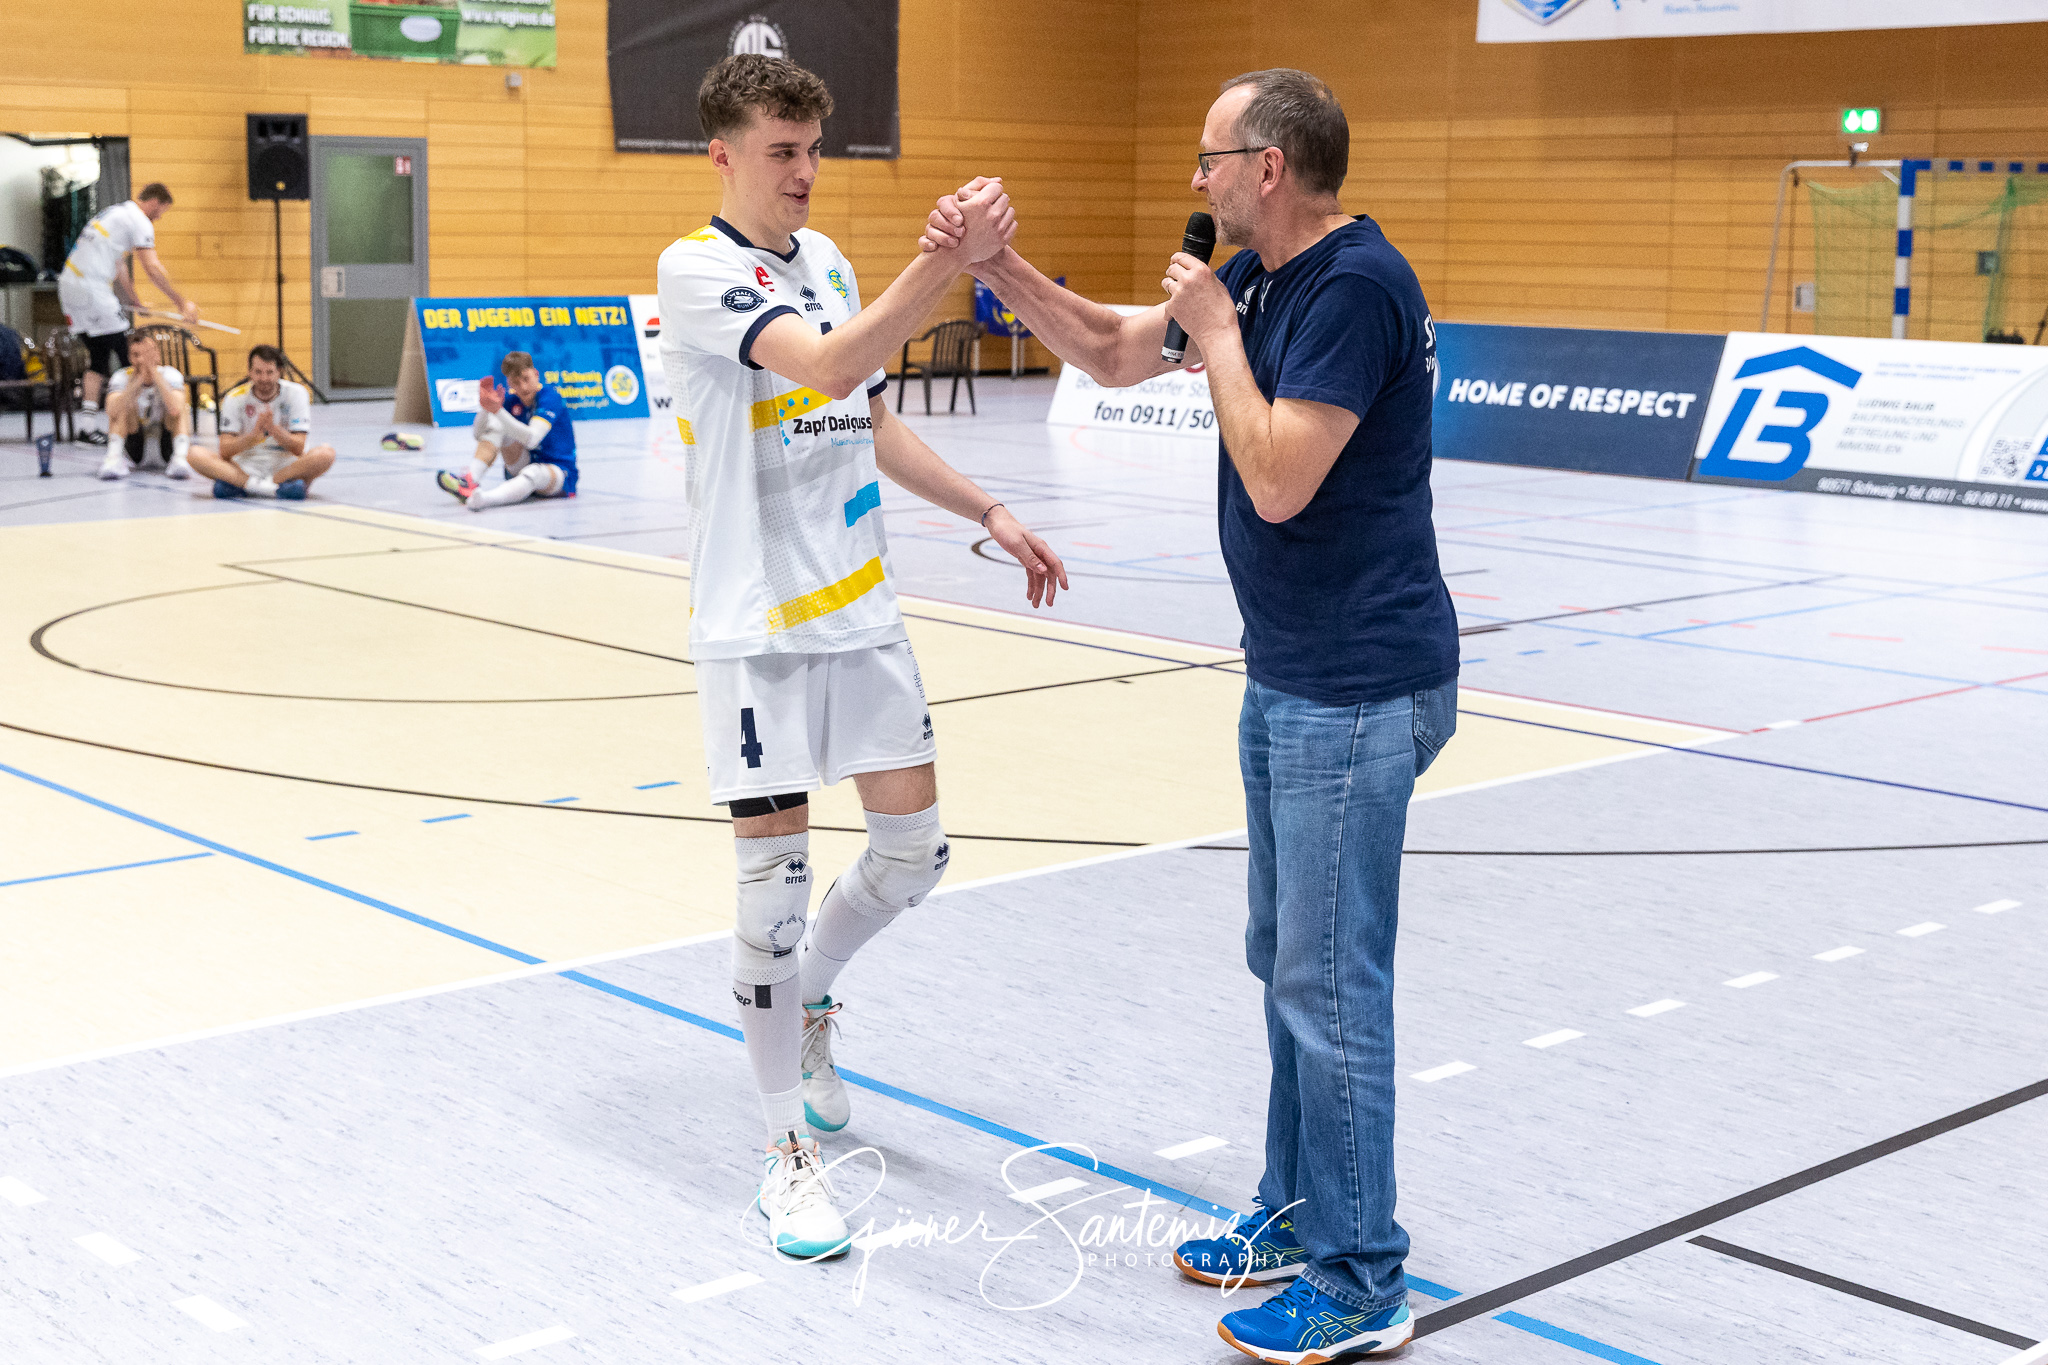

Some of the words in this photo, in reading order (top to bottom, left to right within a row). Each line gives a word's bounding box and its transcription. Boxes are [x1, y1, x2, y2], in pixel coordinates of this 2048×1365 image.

[423, 308, 463, 329] DER
[467, 307, 536, 332] JUGEND
[539, 307, 571, 327] EIN
[574, 306, 628, 326] NETZ!
[1094, 401, 1124, 421] fon
[1448, 378, 1527, 407] HOME
[1529, 383, 1569, 409] OF
[1569, 386, 1697, 418] RESPECT
[793, 415, 826, 437] Zapf
[740, 707, 764, 769] 4
